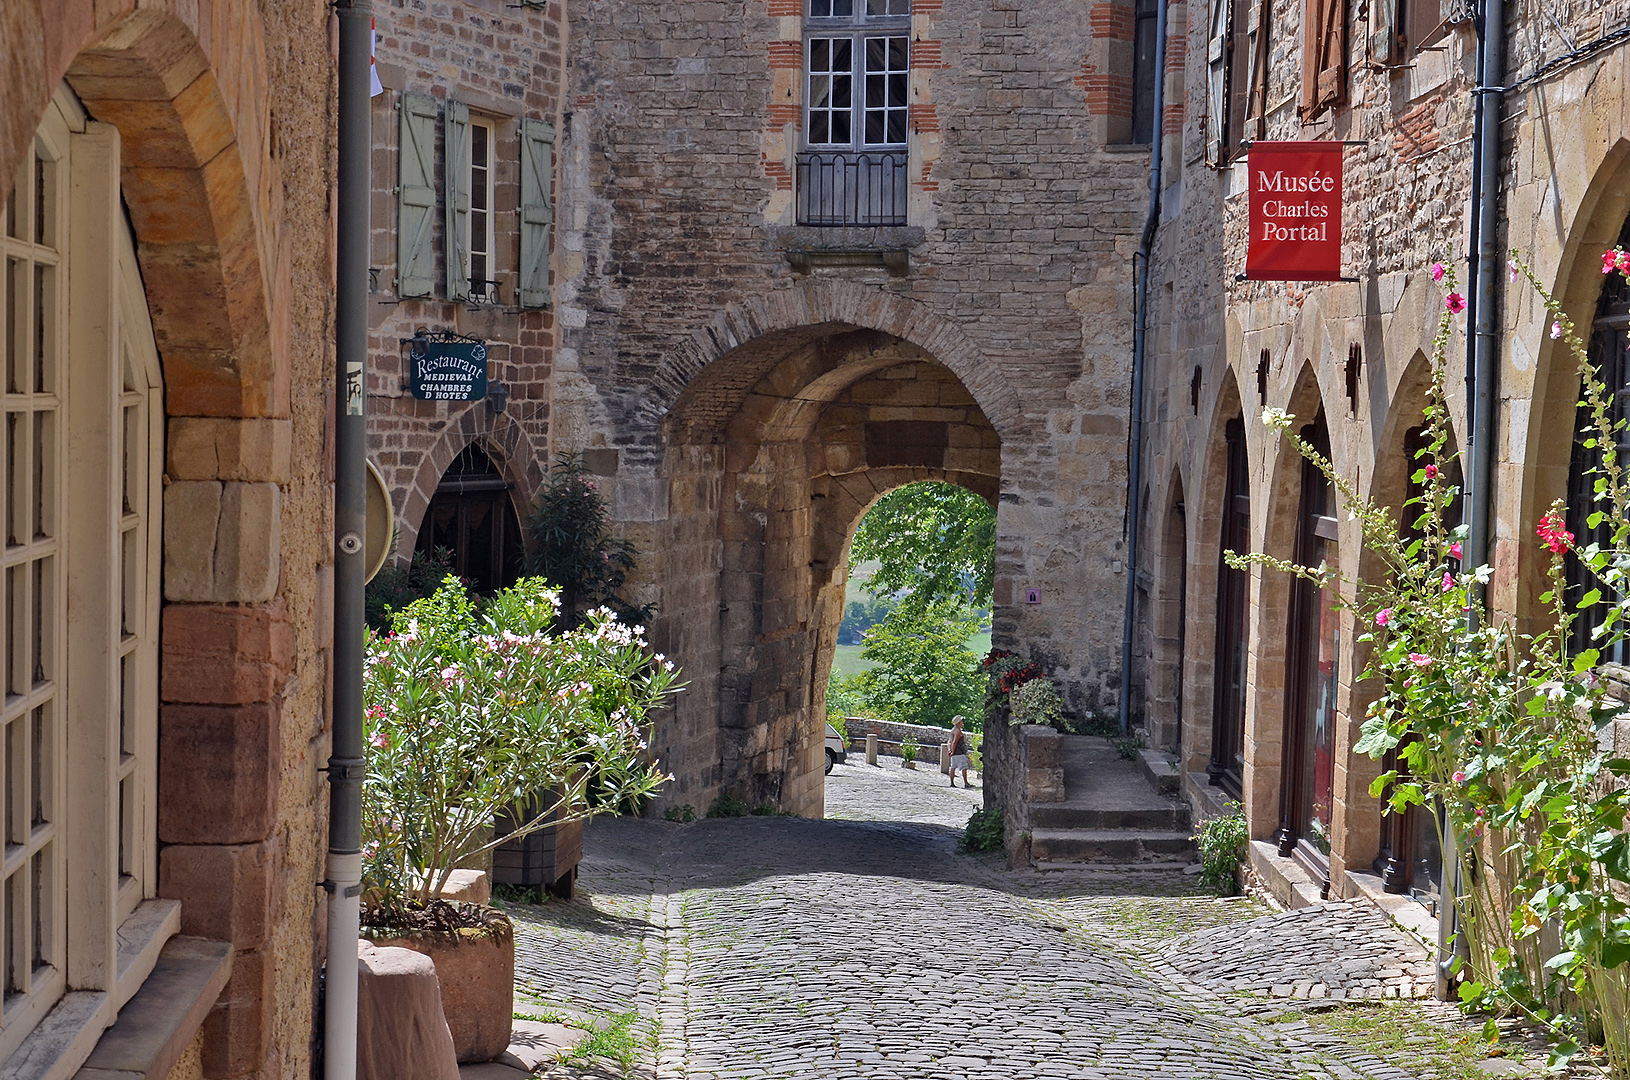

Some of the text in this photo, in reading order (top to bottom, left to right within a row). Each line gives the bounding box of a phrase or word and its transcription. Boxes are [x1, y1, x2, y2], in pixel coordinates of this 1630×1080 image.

[1257, 170, 1335, 192] Musée
[1262, 200, 1329, 217] Charles
[1261, 222, 1327, 241] Portal
[417, 355, 483, 379] Restaurant
[423, 373, 473, 381] MEDIEVAL
[420, 384, 472, 392] CHAMBRES
[435, 392, 468, 400] HOTES
